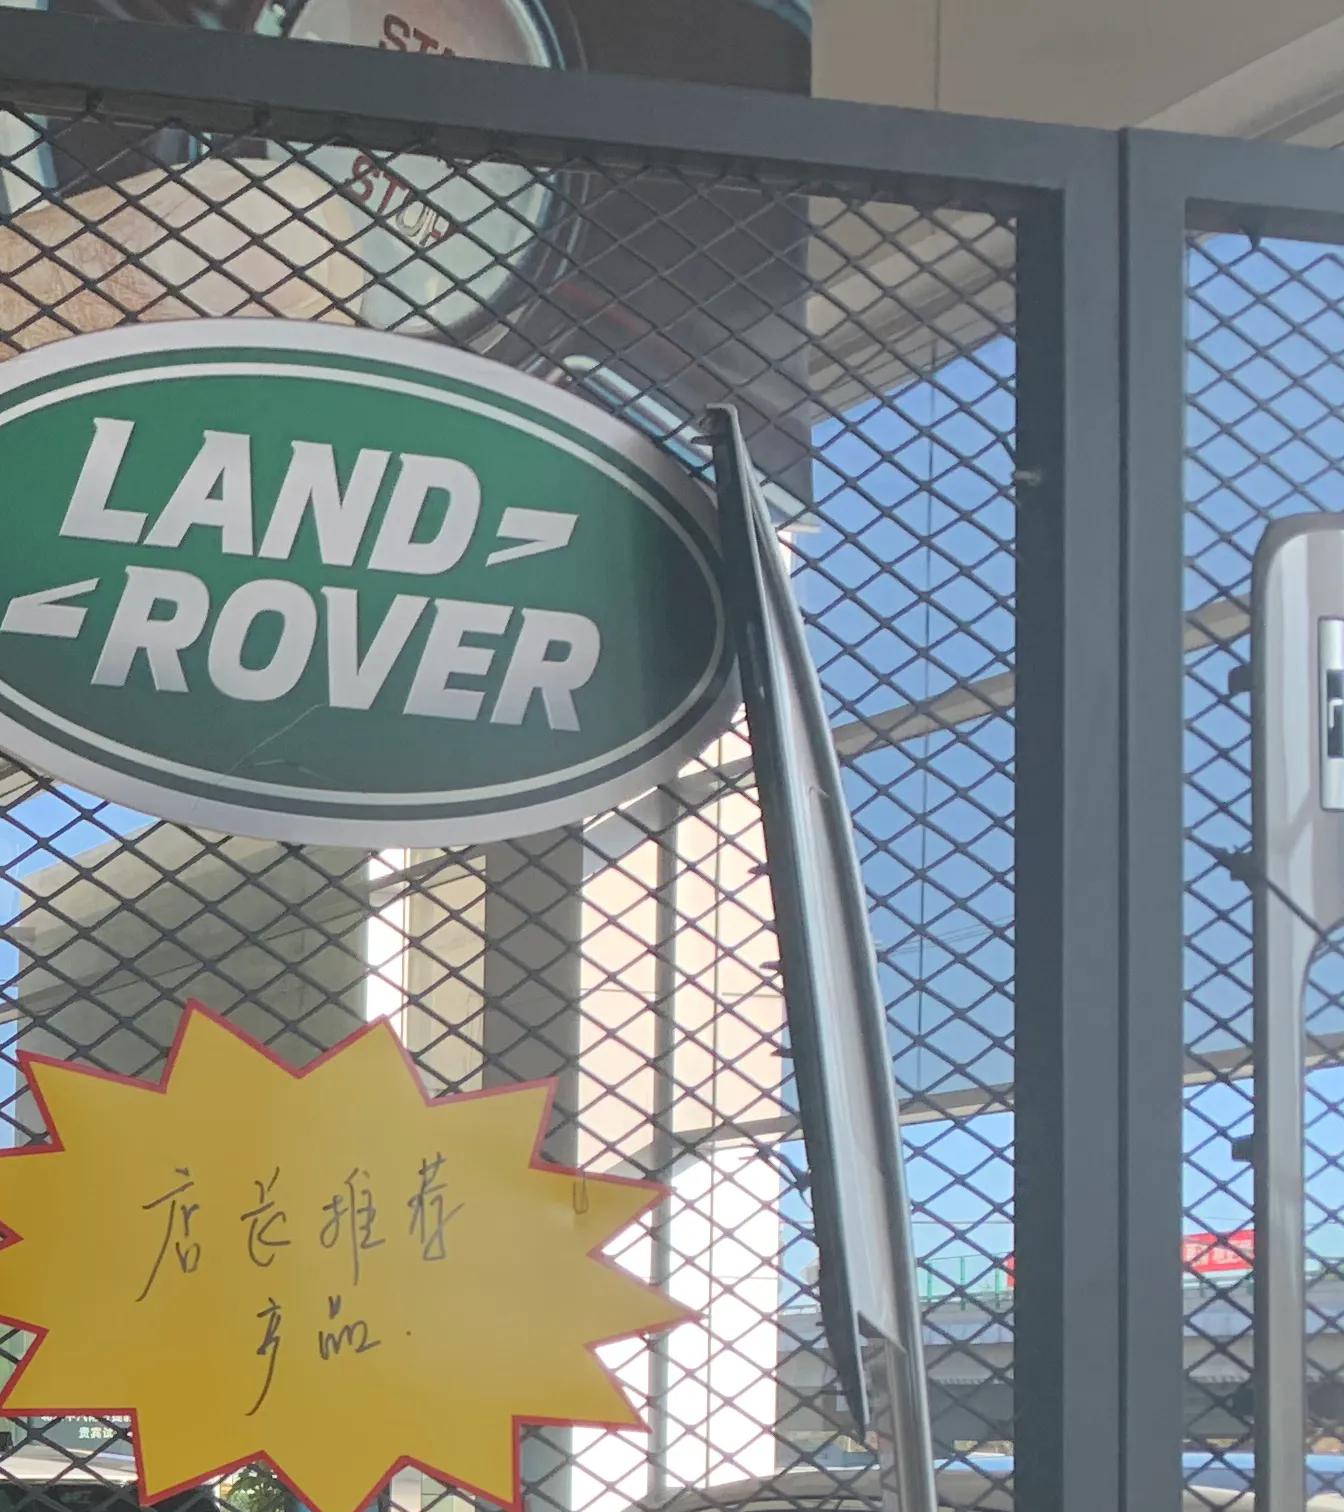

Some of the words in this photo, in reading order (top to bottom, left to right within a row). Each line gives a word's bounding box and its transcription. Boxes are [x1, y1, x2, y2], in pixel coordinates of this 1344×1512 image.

[58, 417, 482, 576] LAND
[91, 565, 601, 732] ROVER
[136, 1151, 466, 1302] 店长推荐
